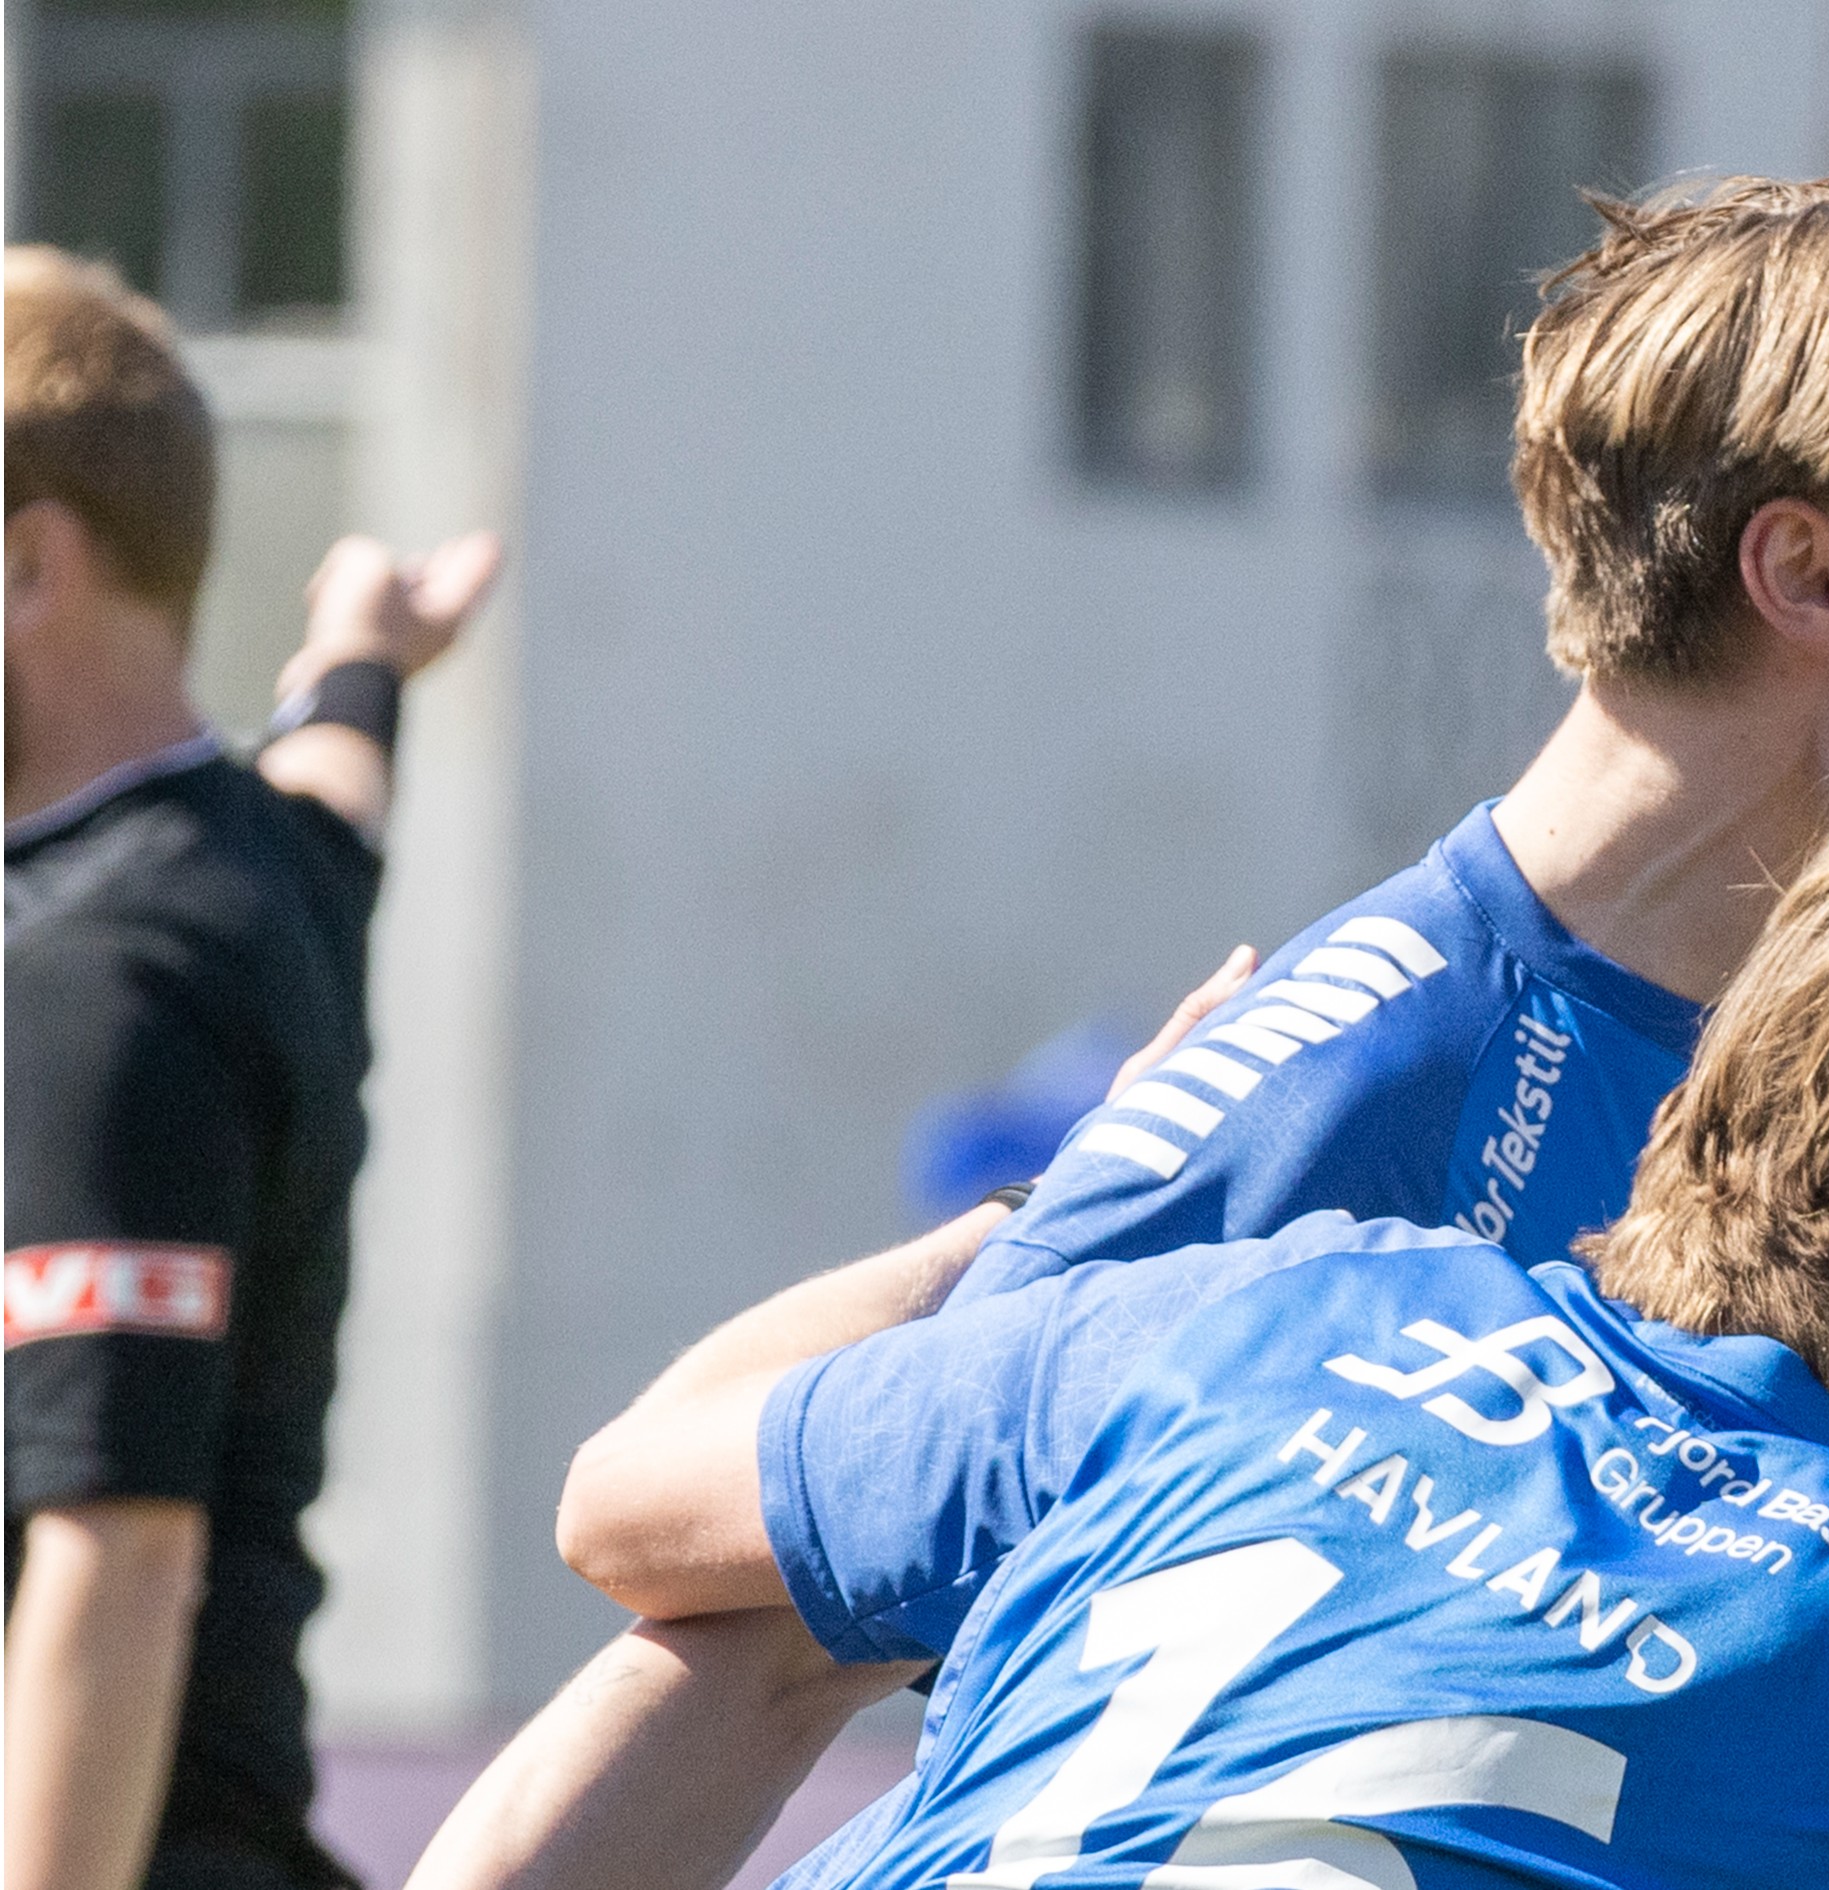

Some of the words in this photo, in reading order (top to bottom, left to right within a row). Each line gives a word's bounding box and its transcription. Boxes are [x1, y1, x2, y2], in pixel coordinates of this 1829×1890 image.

[1456, 1178, 1514, 1243] or
[1276, 1407, 1698, 1694] HAVLAND
[1590, 1448, 1793, 1574] Gruppen
